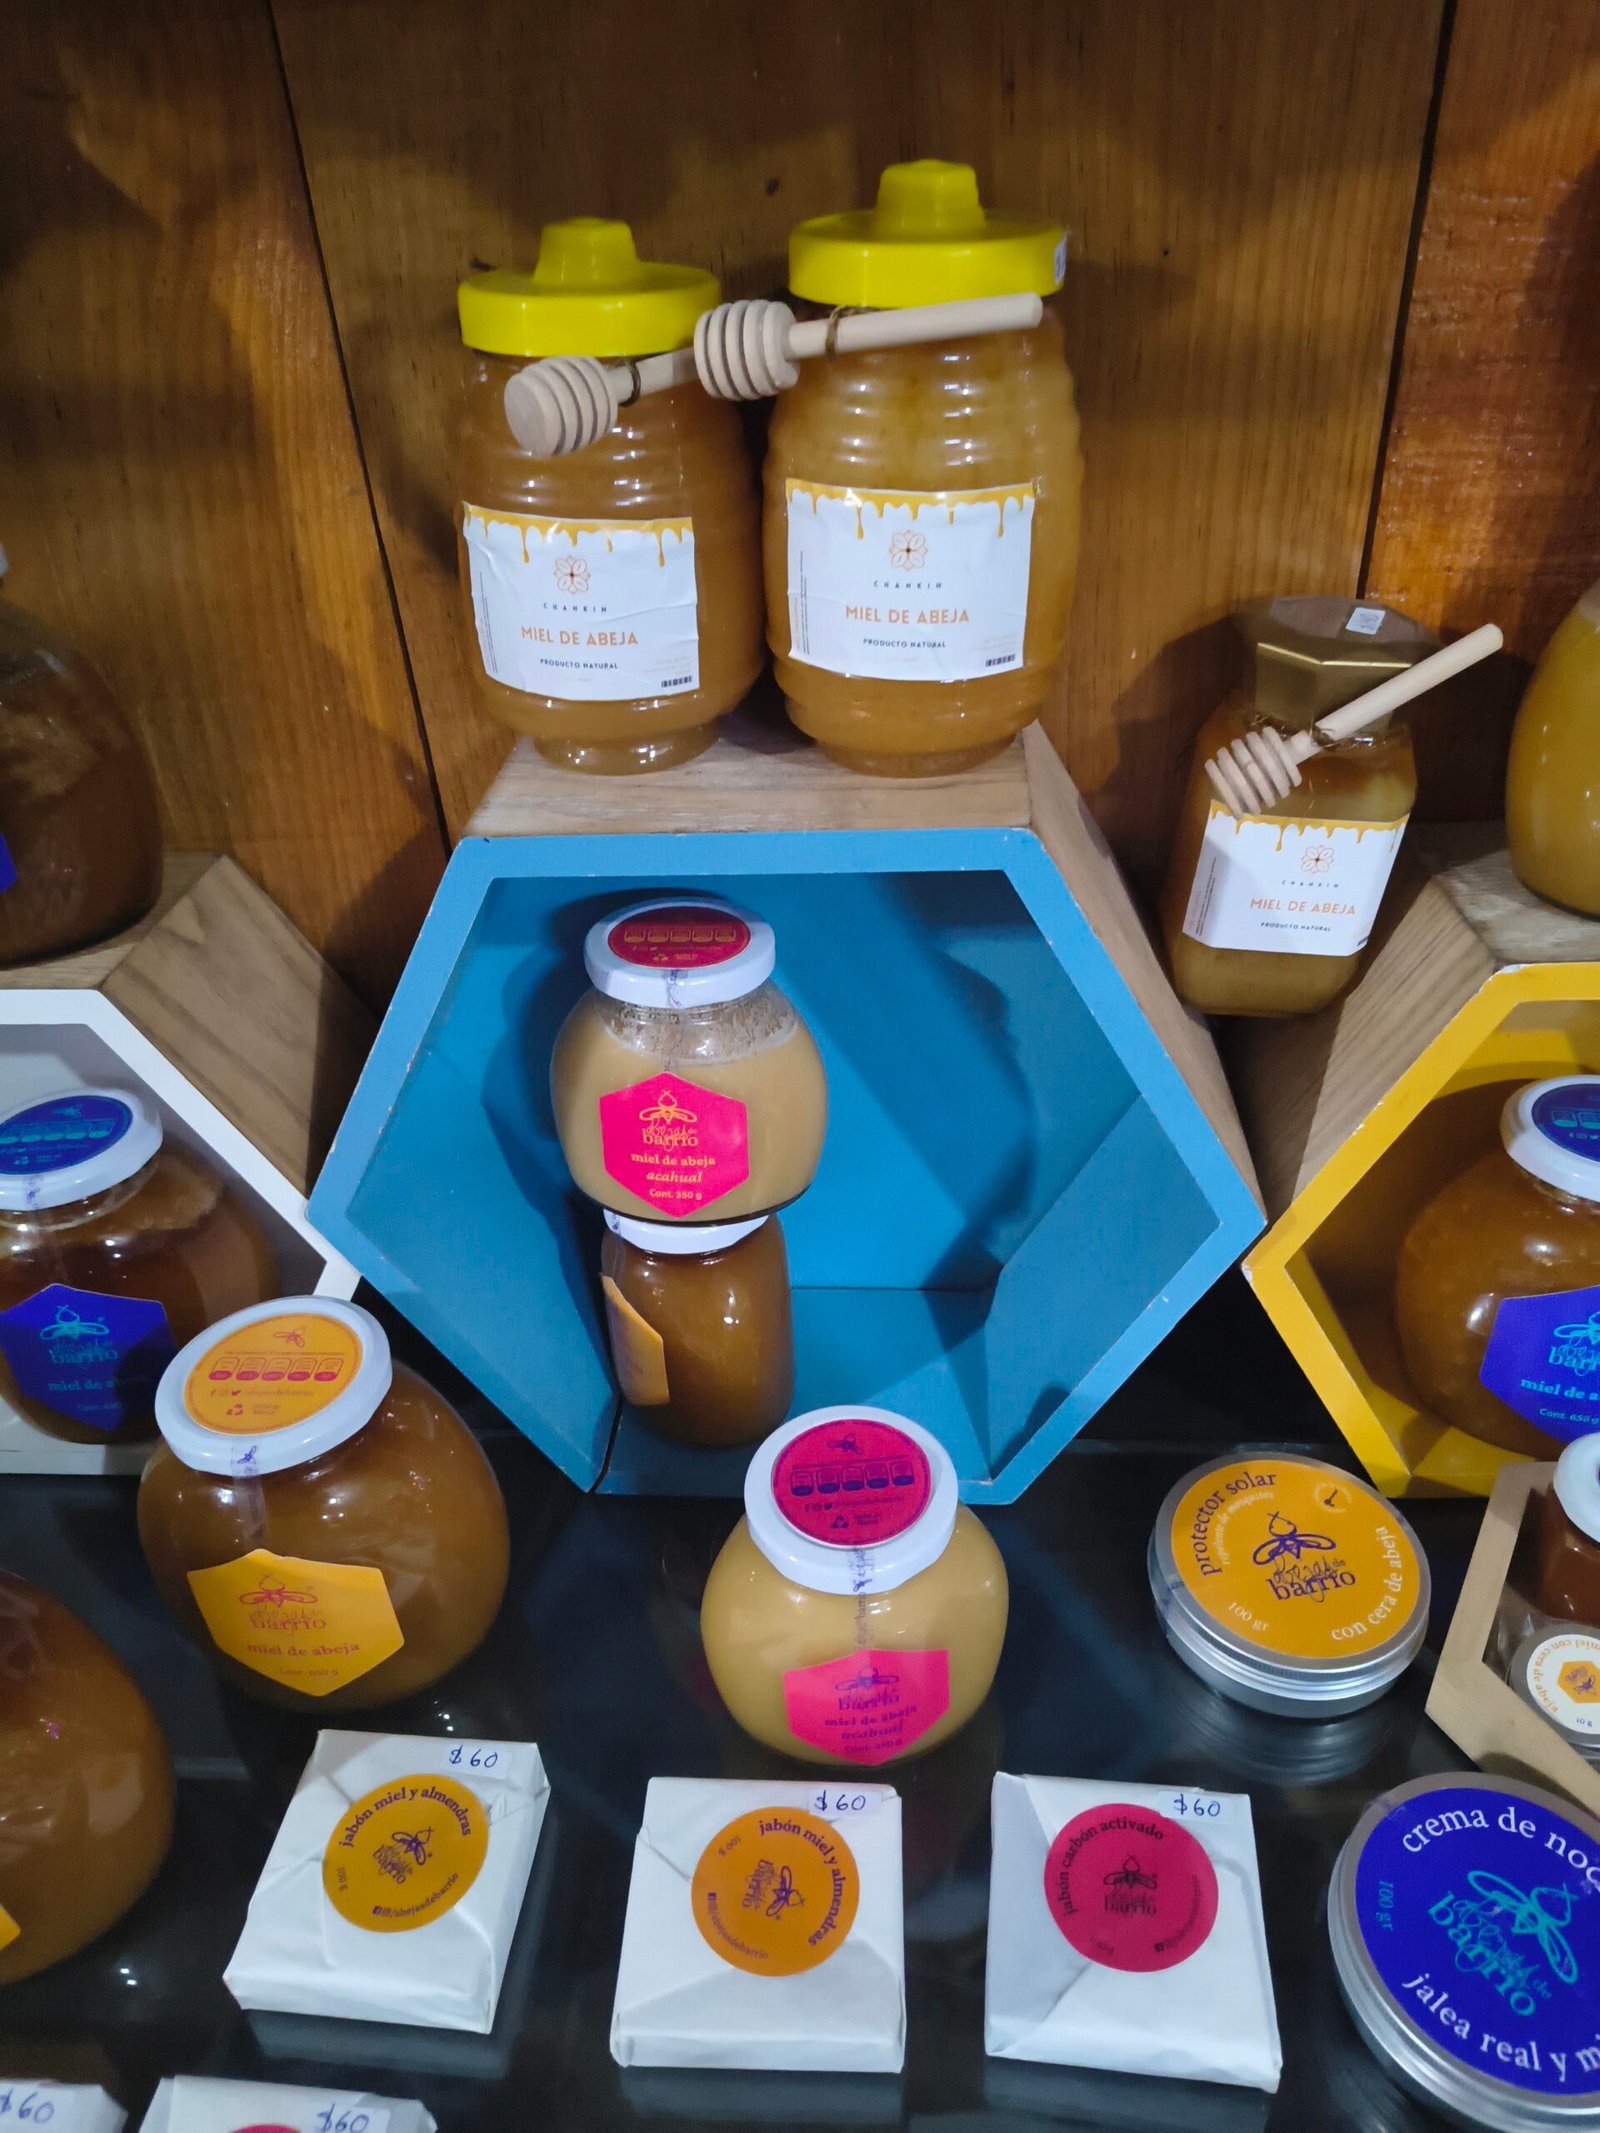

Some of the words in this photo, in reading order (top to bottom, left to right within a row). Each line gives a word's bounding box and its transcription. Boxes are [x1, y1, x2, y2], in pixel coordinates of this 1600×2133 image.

[845, 605, 882, 622] MIEL
[888, 609, 910, 624] DE
[916, 609, 970, 624] ABEJA
[521, 626, 554, 644] MIEL
[560, 631, 580, 646] DE
[586, 632, 638, 647] ABEJA
[863, 638, 907, 648] PRODUCTO
[910, 641, 946, 649] NATURAL
[539, 658, 581, 669] PRODUCTO
[583, 662, 618, 670] NATURAL
[1250, 898, 1281, 911] MIEL
[1288, 901, 1308, 912] DE
[1311, 903, 1356, 915] ABEJA
[1261, 922, 1299, 930] PRODUCTO
[642, 1128, 698, 1147] barrio
[631, 1153, 659, 1164] miel
[662, 1155, 678, 1166] de
[681, 1155, 716, 1169] abeja
[646, 1171, 703, 1183] acahual
[649, 1188, 674, 1198] Cont.
[696, 1192, 702, 1200] g
[1521, 1380, 1561, 1395] miel
[1564, 1387, 1585, 1399] de
[1570, 1414, 1590, 1422] 650
[1190, 1490, 1226, 1577] protector
[1226, 1471, 1277, 1496] solar
[1376, 1526, 1402, 1568] abeja
[1267, 1571, 1356, 1601] barrio
[1383, 1573, 1402, 1593] de
[1227, 1602, 1252, 1622] 100
[1252, 1618, 1270, 1632] gr
[1368, 1594, 1397, 1626] cera
[1332, 1620, 1368, 1641] con
[248, 1644, 282, 1655] miel
[287, 1646, 307, 1657] de
[312, 1643, 360, 1656] abeja
[825, 1717, 856, 1726] miel
[860, 1717, 876, 1725] de
[881, 1706, 918, 1722] abeja
[1173, 1794, 1221, 1817] $60
[339, 1809, 374, 1848] jabón
[374, 1786, 407, 1811] miel
[409, 1788, 420, 1801] y
[421, 1786, 472, 1837] almendras
[759, 1818, 800, 1837] jabón
[1402, 1807, 1490, 1853] crema
[1498, 1806, 1537, 1838] de
[803, 1828, 834, 1857] miel
[1063, 1826, 1098, 1869] carbón
[1101, 1816, 1164, 1841] activado
[823, 1855, 838, 1865] y
[1378, 1880, 1395, 1910] 100
[808, 1868, 847, 1947] almendras
[1375, 1911, 1394, 1932] gr
[1428, 1890, 1536, 2017] barrio
[1402, 1973, 1471, 2040] jalea
[1479, 2032, 1542, 2072] real
[1549, 2052, 1567, 2083] y
